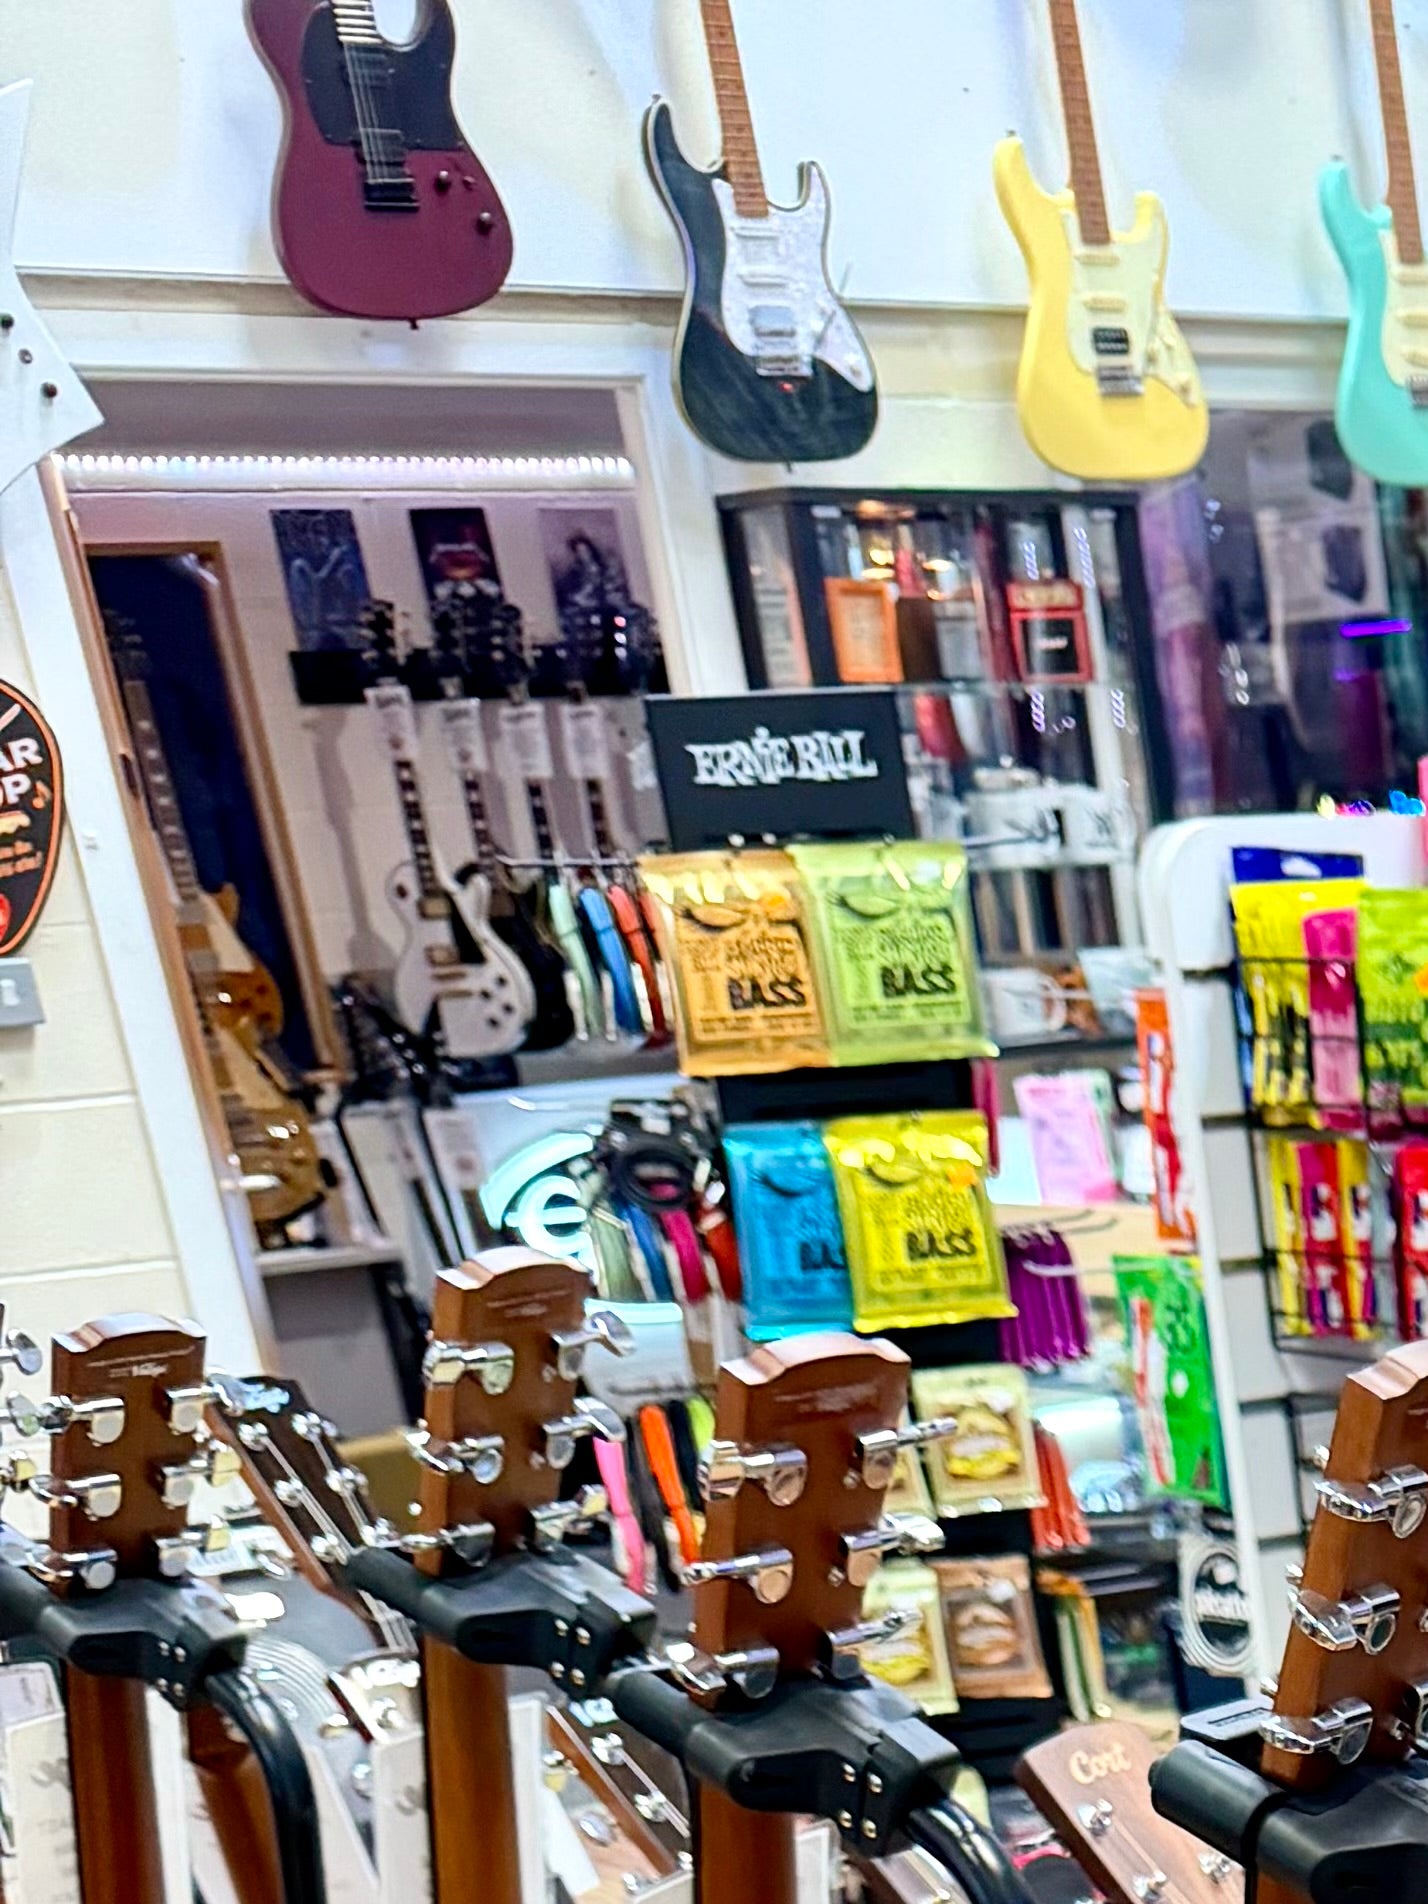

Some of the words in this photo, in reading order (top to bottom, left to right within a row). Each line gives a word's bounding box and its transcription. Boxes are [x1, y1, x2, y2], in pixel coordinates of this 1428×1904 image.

[684, 725, 793, 785] ERNIE
[798, 730, 878, 781] BALL
[728, 976, 807, 1011] BASS
[881, 964, 956, 998] BASS
[906, 1228, 977, 1262] BASS
[1069, 1743, 1132, 1785] Cort
